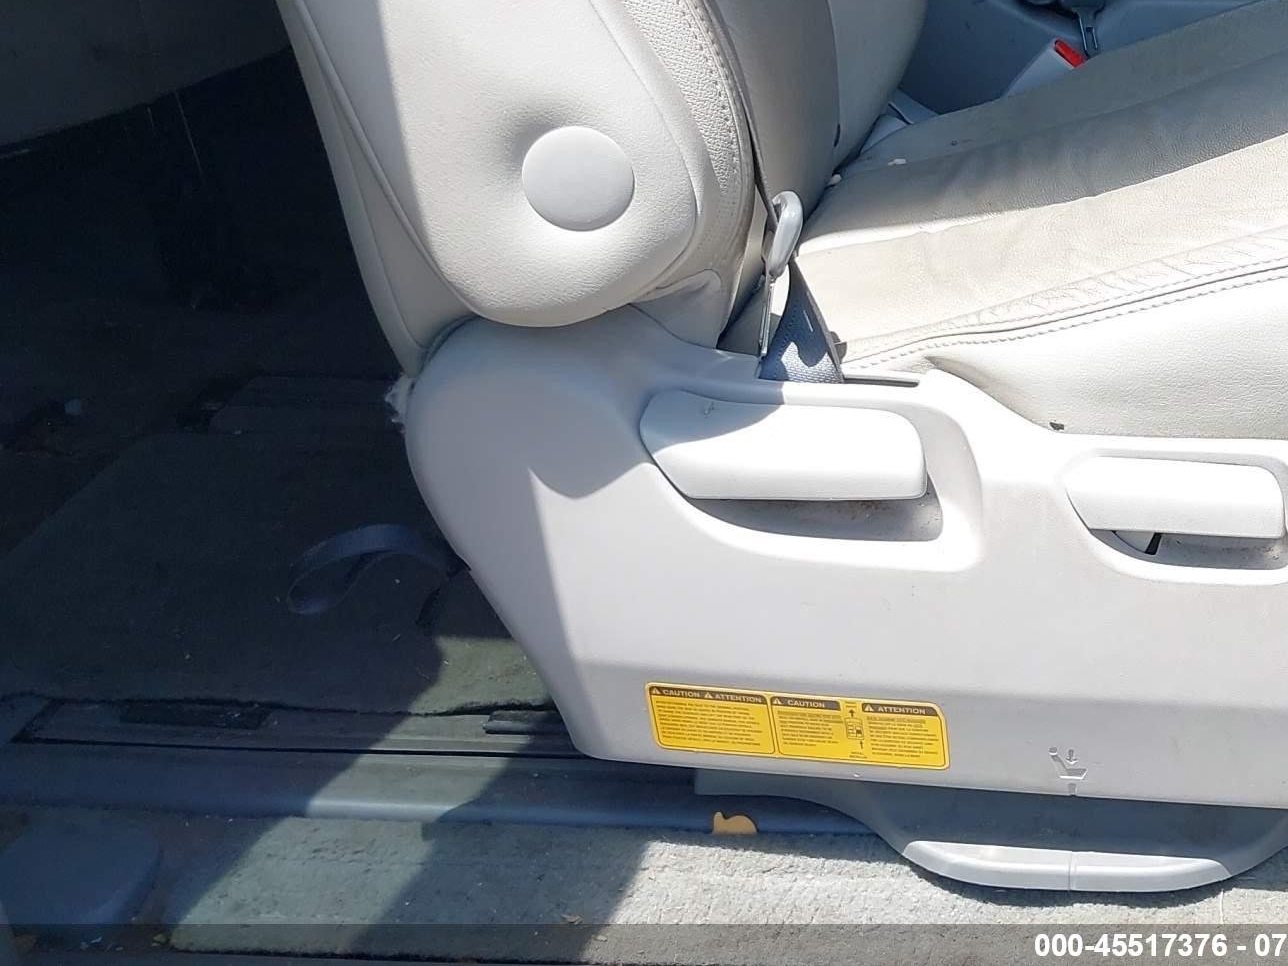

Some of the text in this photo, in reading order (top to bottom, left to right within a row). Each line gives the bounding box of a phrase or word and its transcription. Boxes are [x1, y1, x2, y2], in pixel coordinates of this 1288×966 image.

[663, 689, 762, 704] CAUTION ATTENTION
[787, 699, 825, 708] CAUTION
[877, 705, 926, 715] ATTENTION
